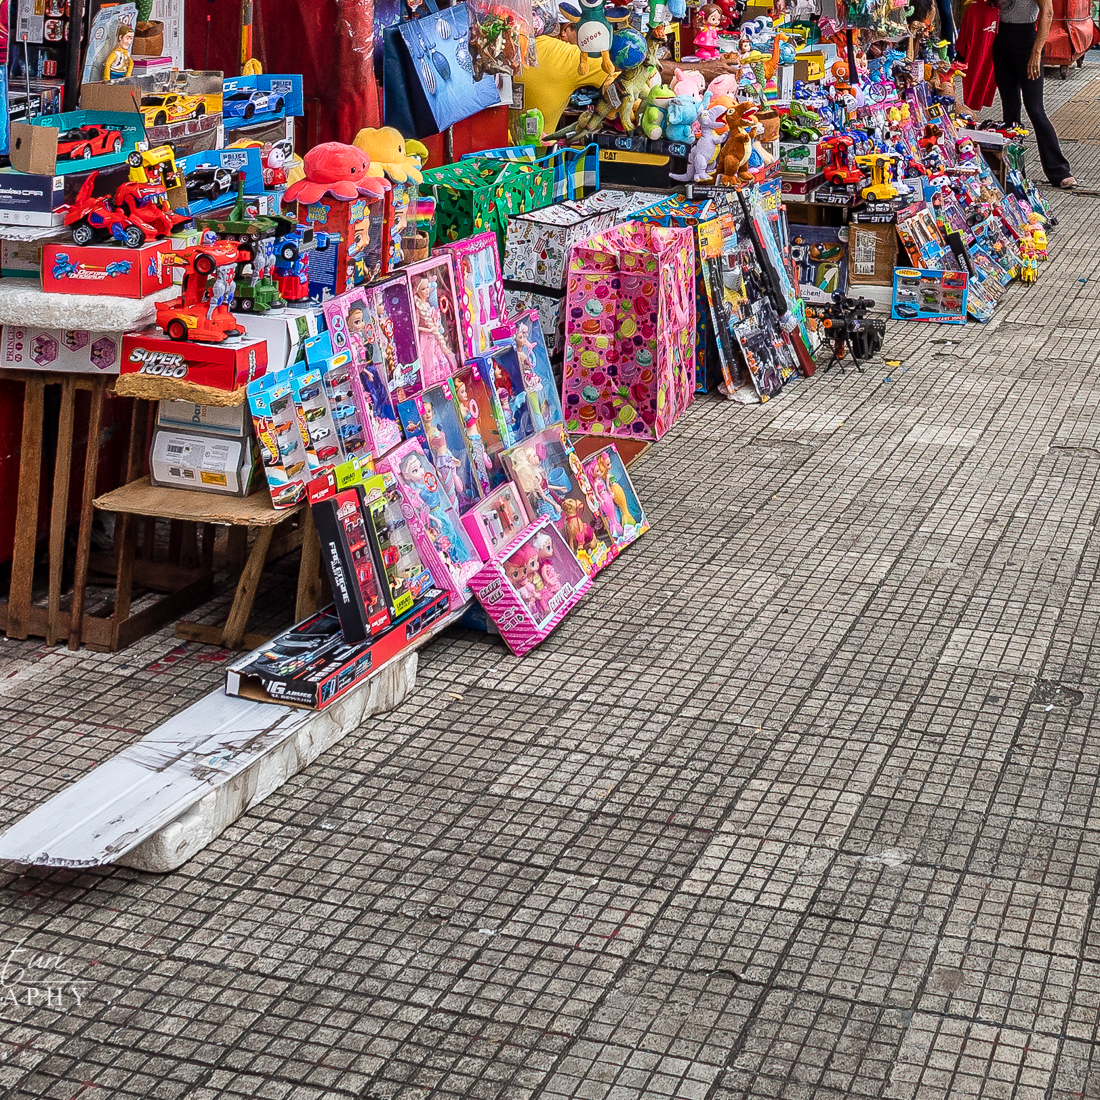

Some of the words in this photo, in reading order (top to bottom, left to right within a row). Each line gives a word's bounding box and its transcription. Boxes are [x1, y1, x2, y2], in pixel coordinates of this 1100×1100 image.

[222, 152, 247, 161] POLICE
[603, 151, 617, 161] CAT
[827, 196, 851, 204] AUG
[129, 348, 185, 367] SUPER
[138, 361, 188, 378] ROBO
[328, 540, 341, 564] FIRE
